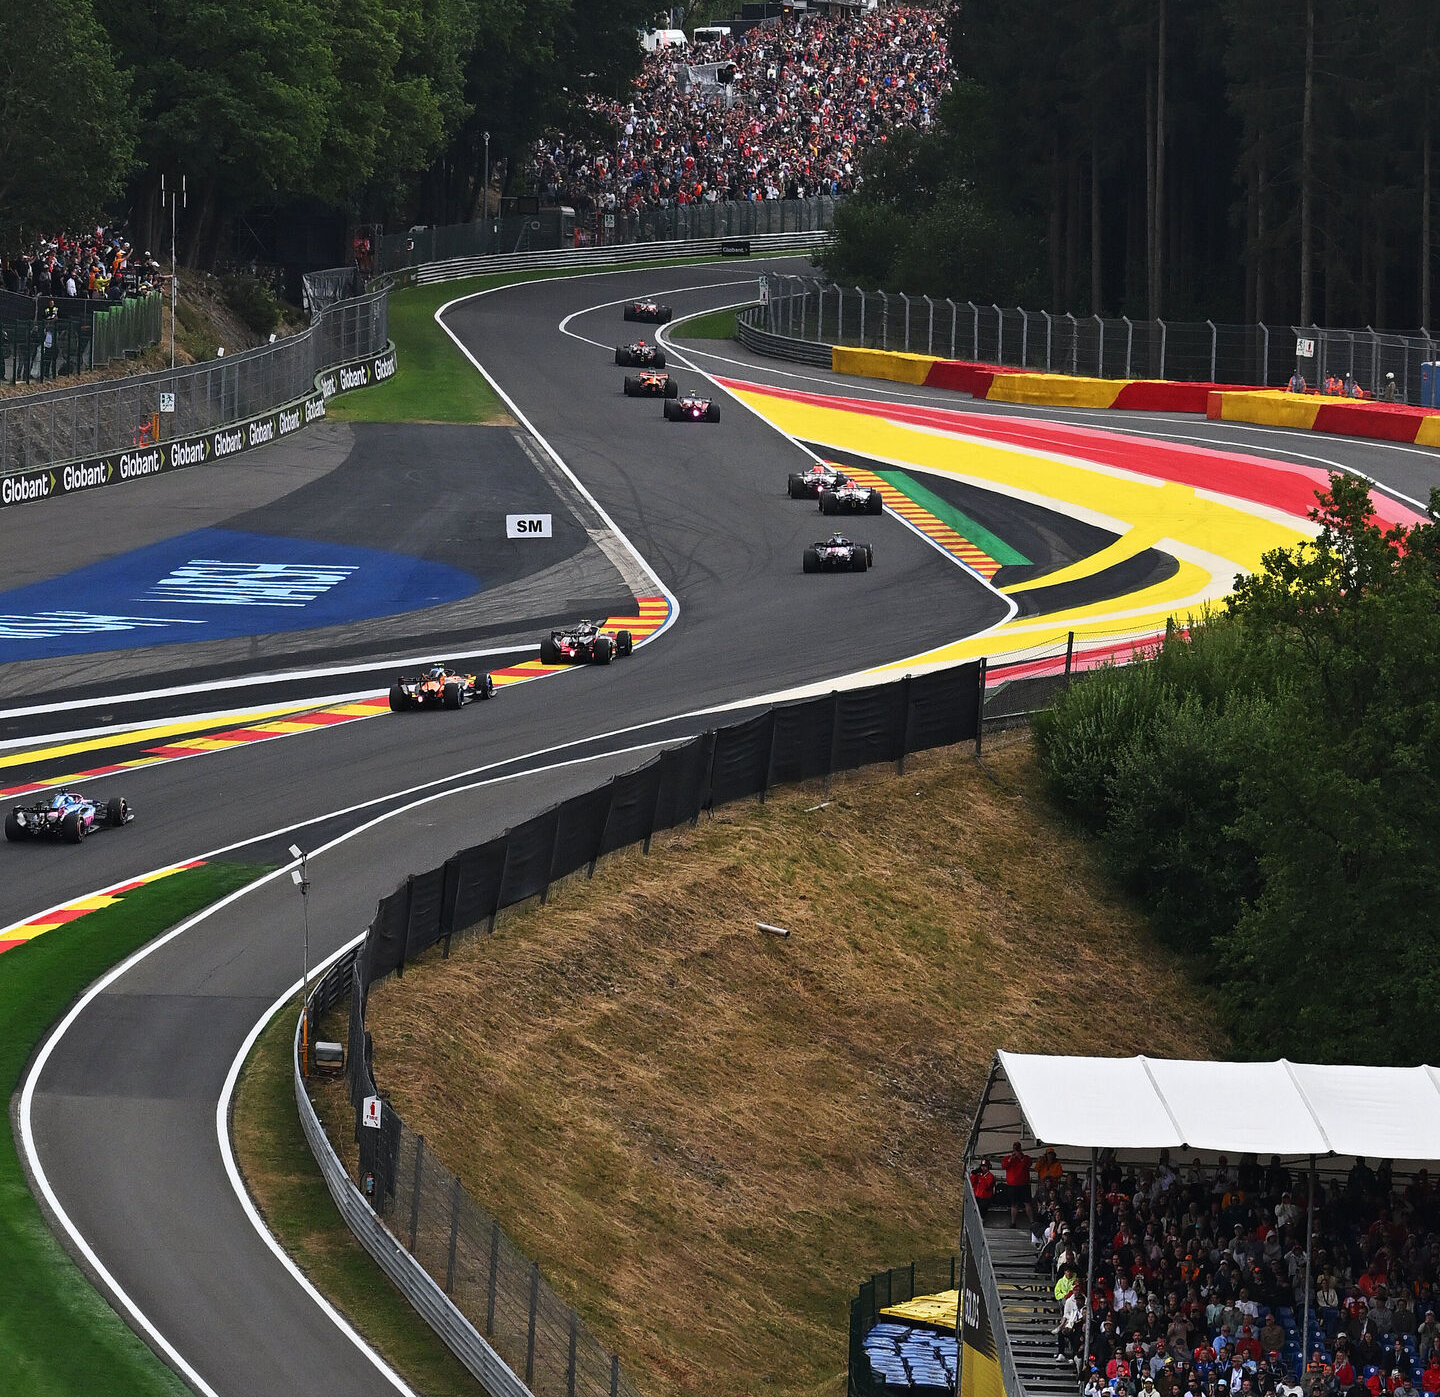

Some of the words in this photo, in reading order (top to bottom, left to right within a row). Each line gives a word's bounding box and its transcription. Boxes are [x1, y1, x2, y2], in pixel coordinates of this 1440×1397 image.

[340, 366, 367, 390] Globant
[249, 420, 274, 445] Globant
[279, 410, 300, 434] Globant
[170, 440, 205, 466] Globant
[214, 429, 242, 456] Globant
[64, 462, 106, 491] Globant
[120, 451, 160, 478] Globant
[2, 474, 48, 503] Globant
[516, 520, 542, 532] SM
